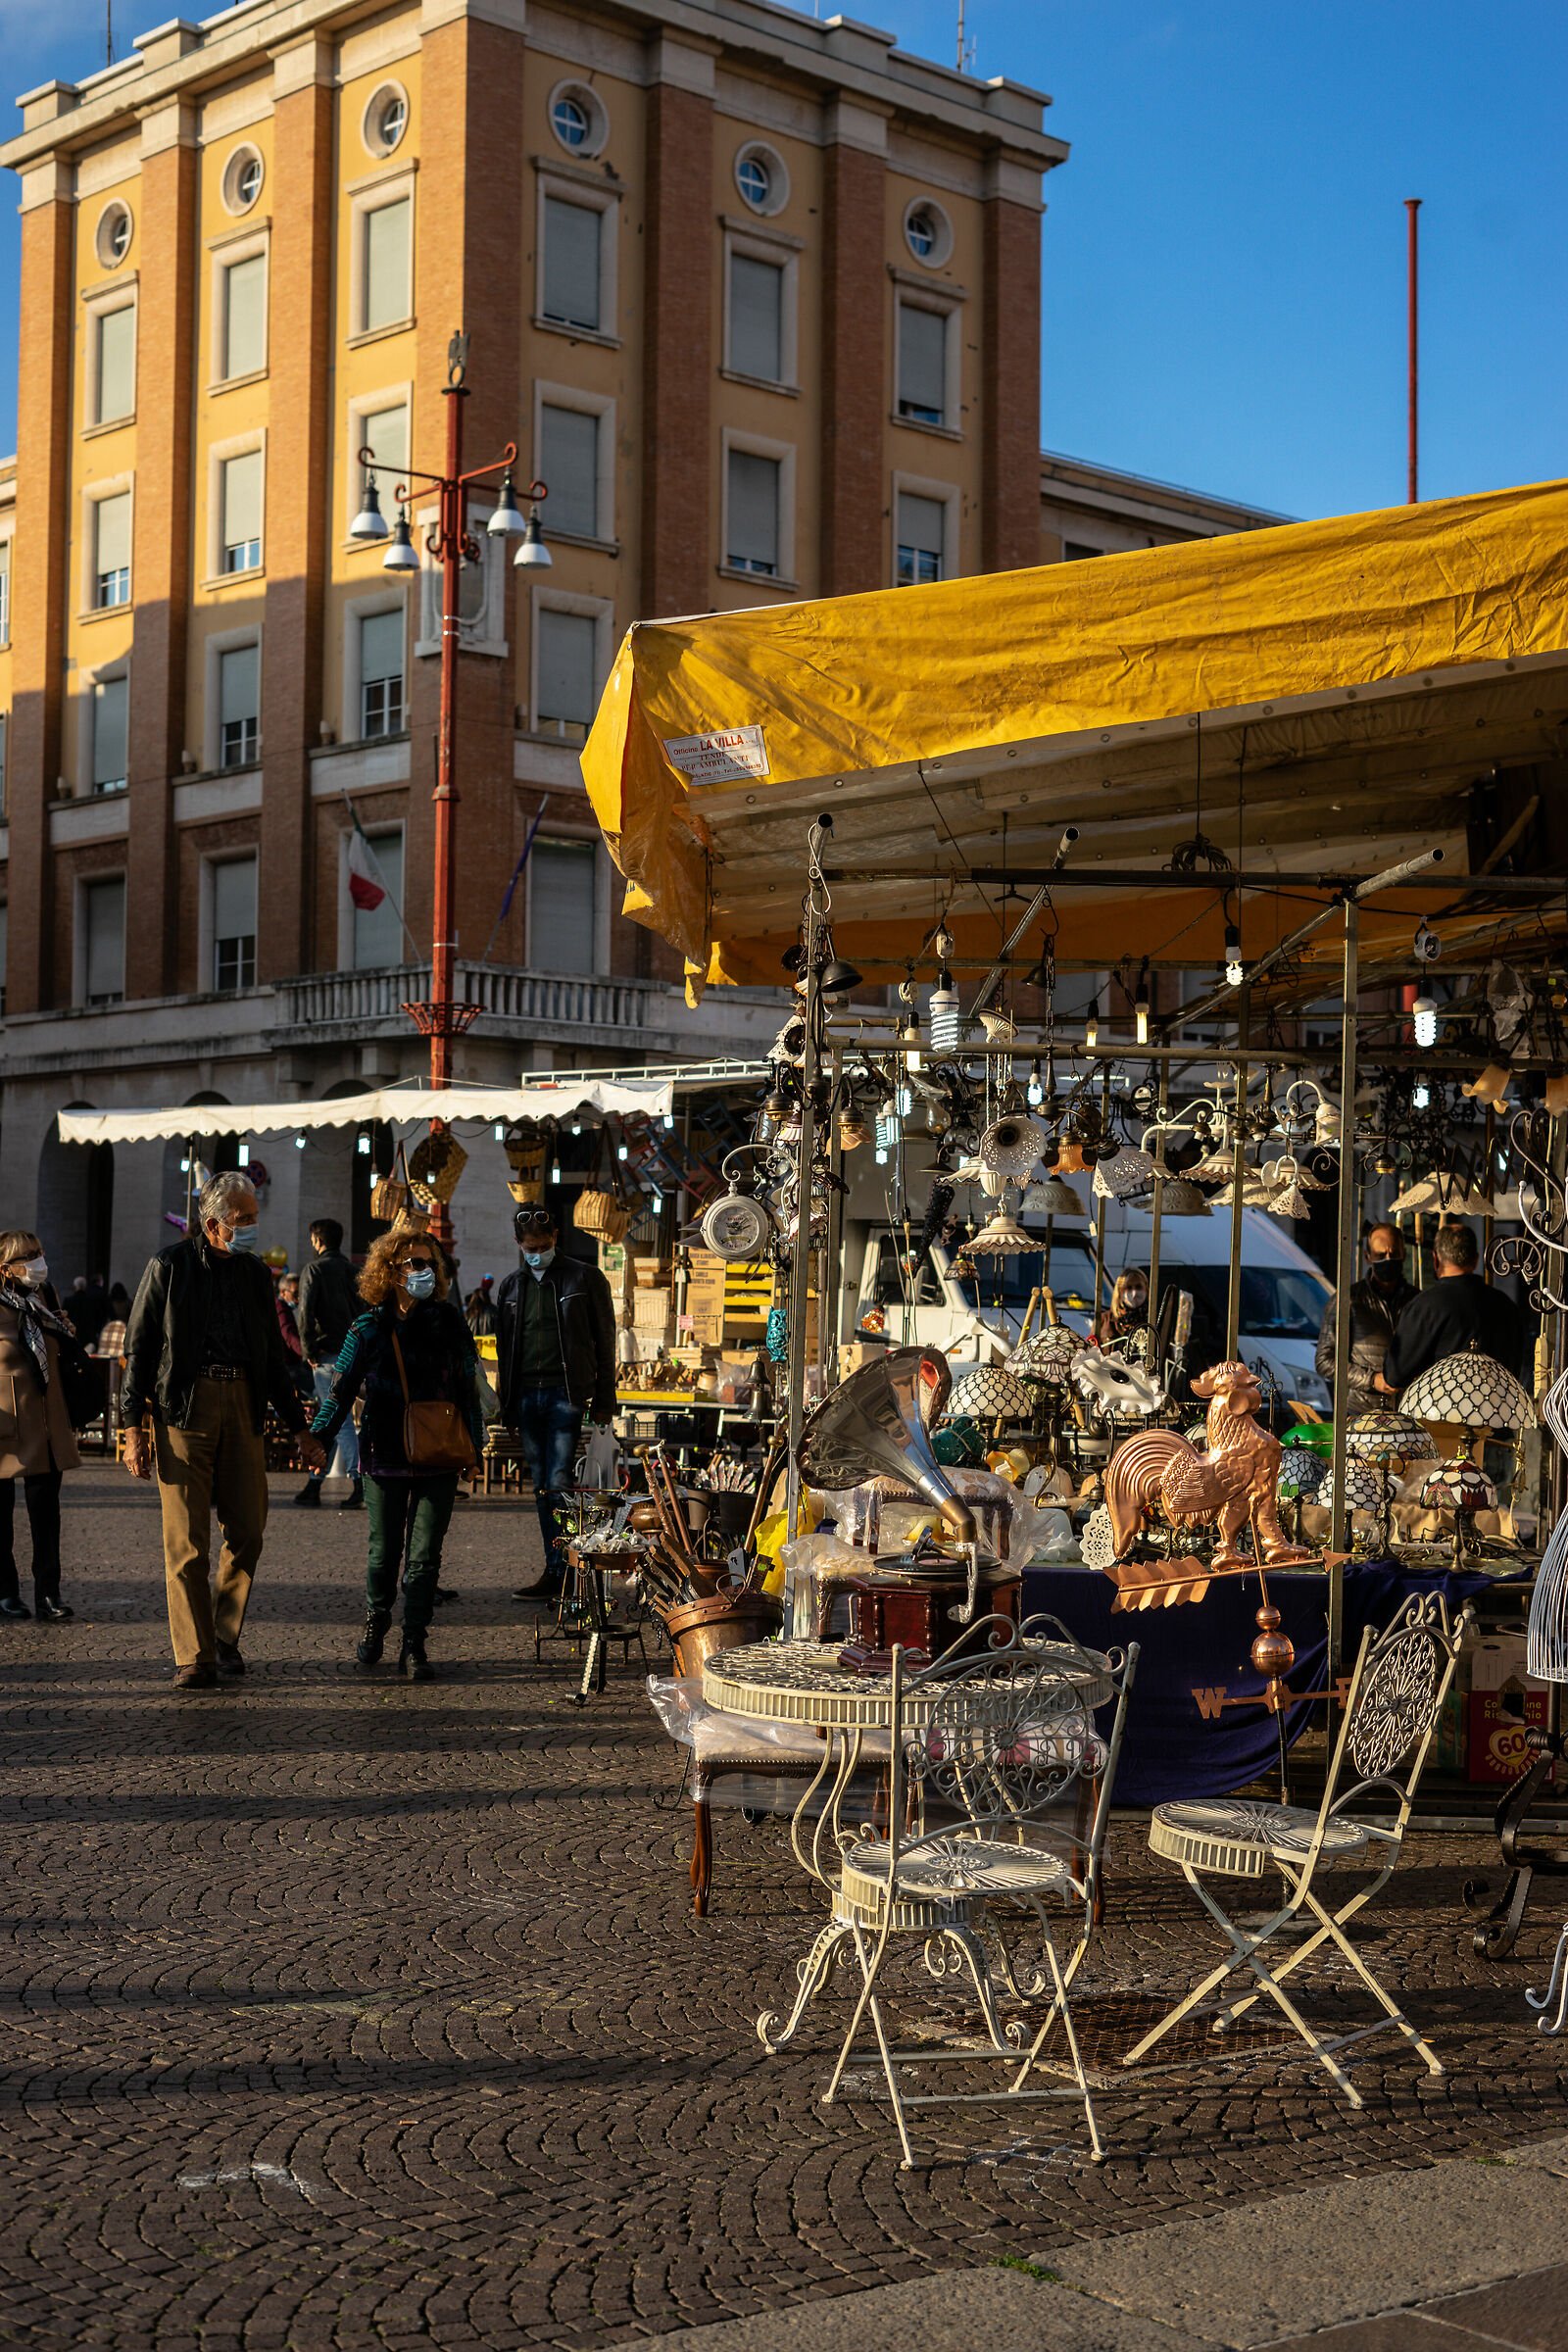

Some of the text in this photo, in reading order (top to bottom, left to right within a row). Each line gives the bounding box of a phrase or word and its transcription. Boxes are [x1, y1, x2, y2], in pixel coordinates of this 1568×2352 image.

[700, 739, 713, 752] LA
[715, 735, 744, 748] VILLA
[1192, 1687, 1227, 1720] W
[1497, 1733, 1525, 1757] 60
